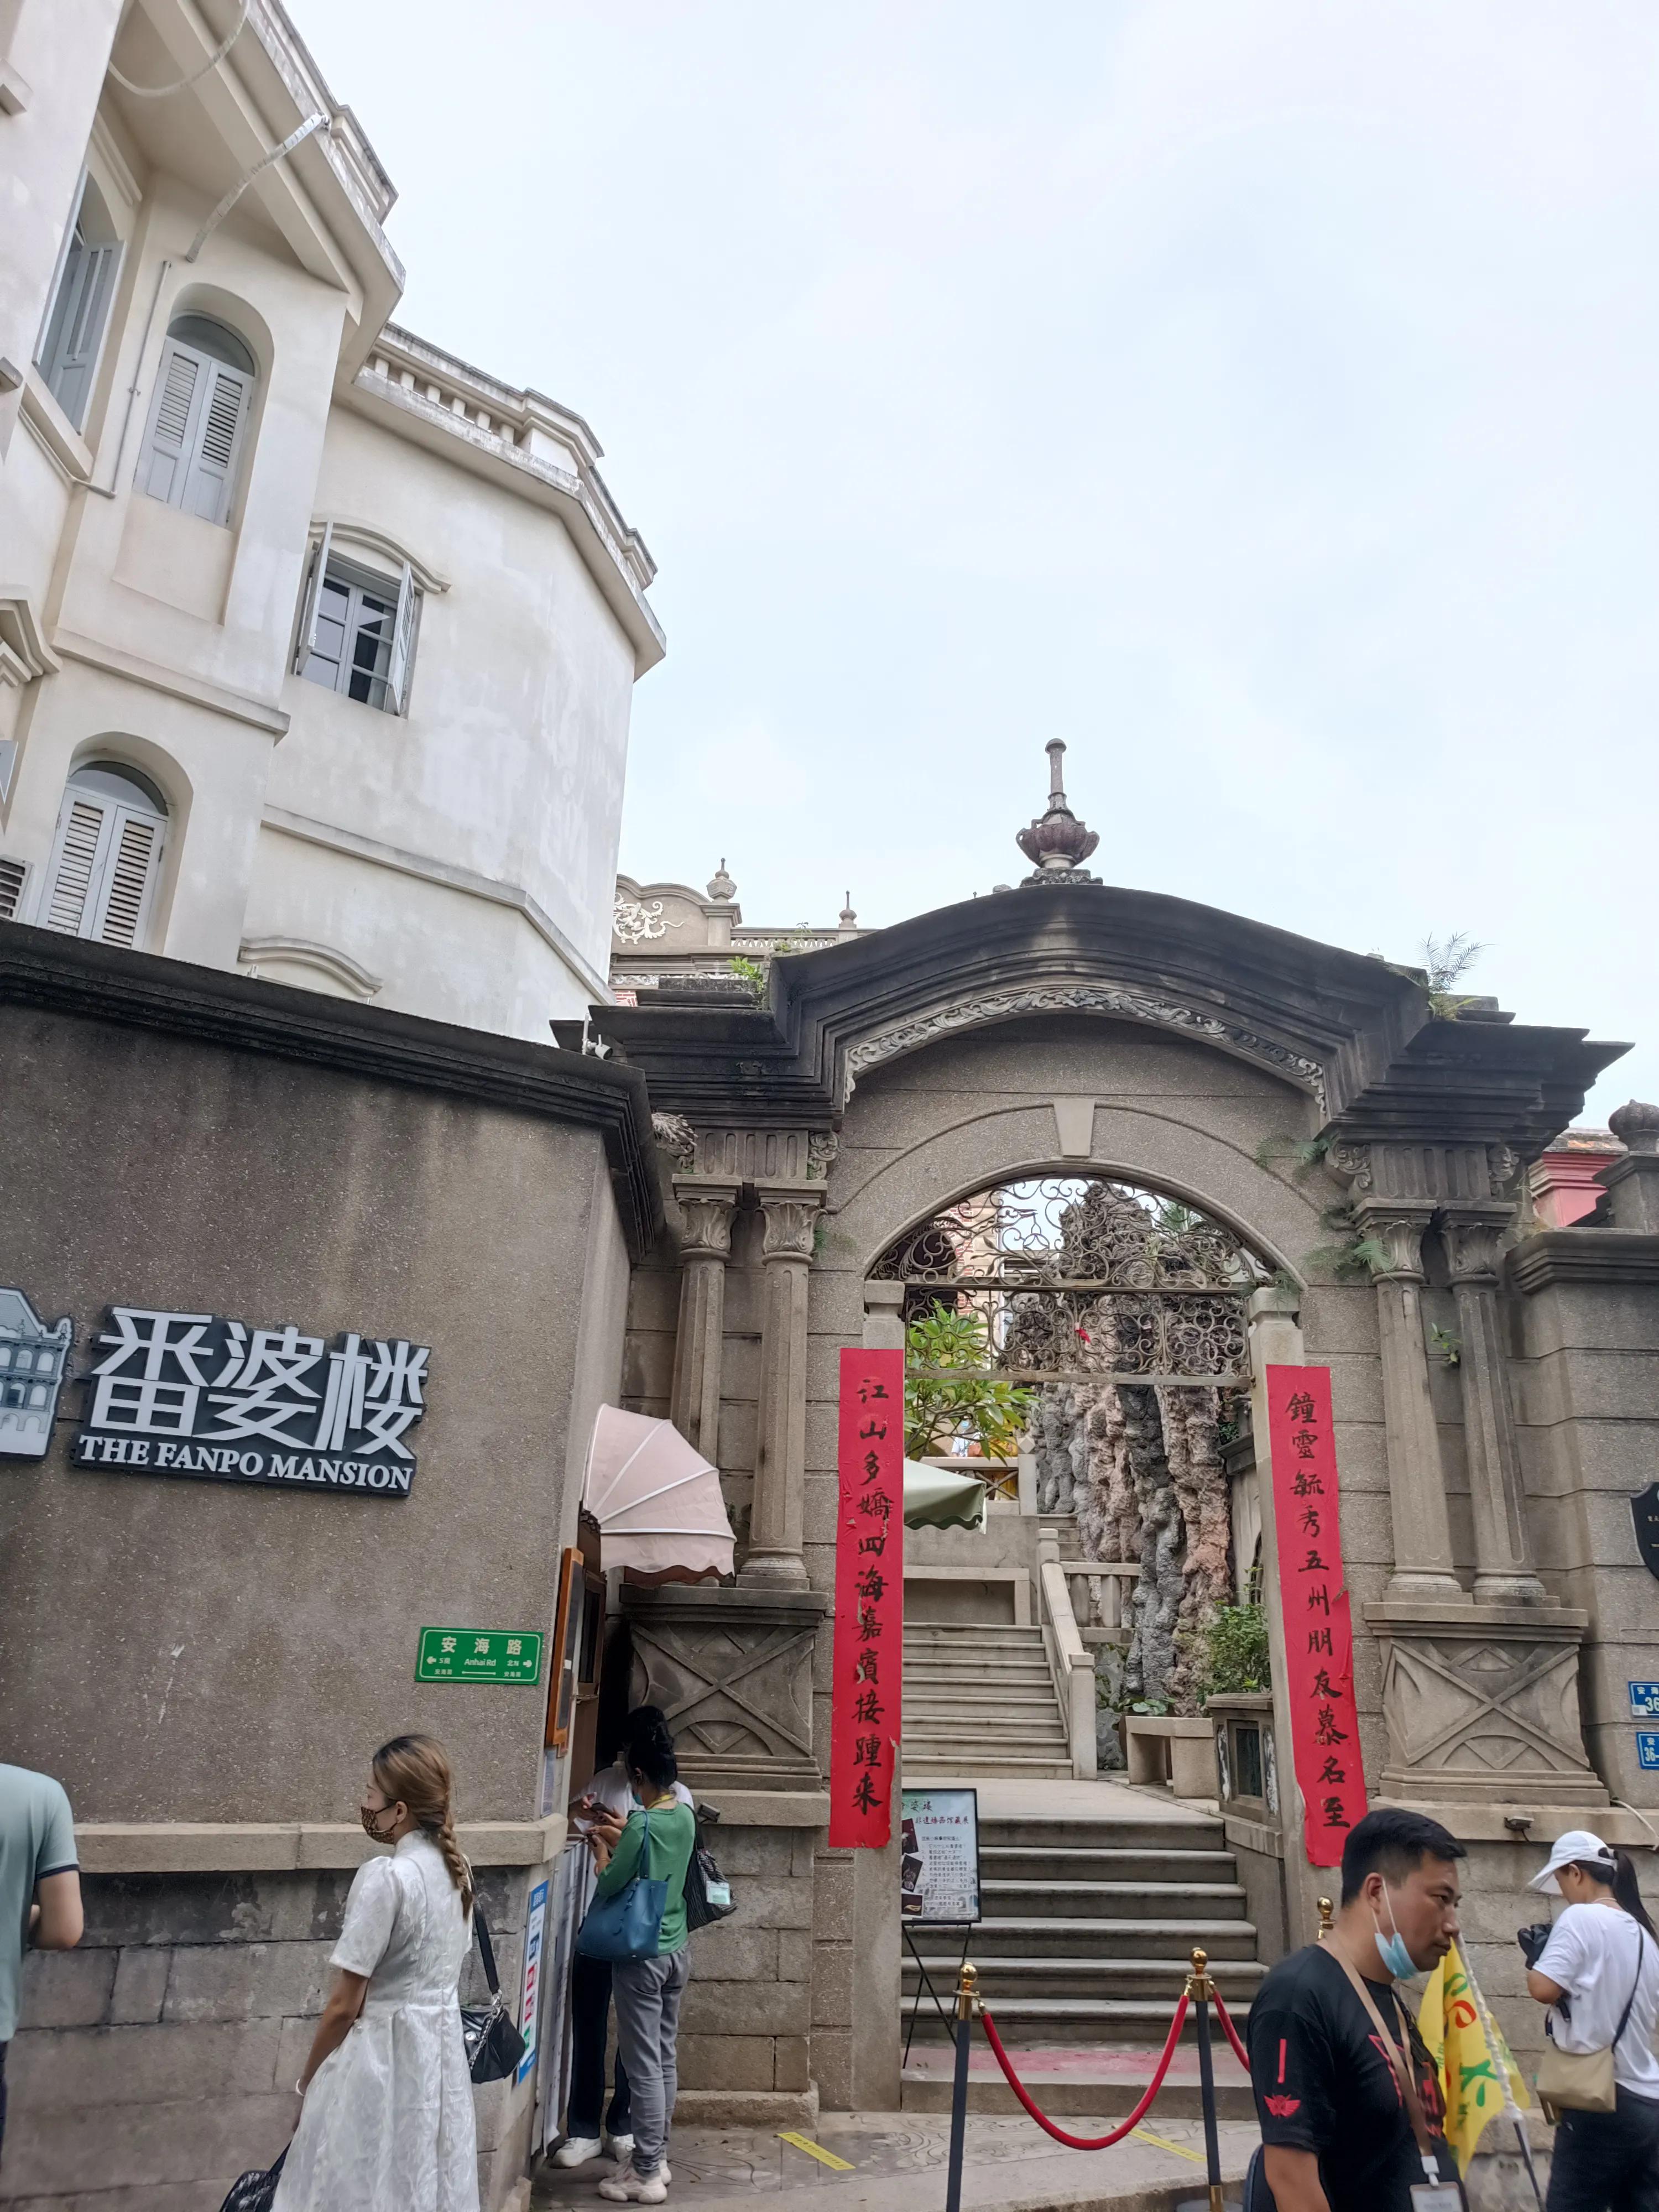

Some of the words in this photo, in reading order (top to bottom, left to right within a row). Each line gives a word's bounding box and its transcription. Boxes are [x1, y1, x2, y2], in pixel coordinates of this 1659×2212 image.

[91, 1306, 432, 1459] 番婆楼
[79, 1434, 150, 1465] THE
[154, 1442, 264, 1476] FANPO
[267, 1453, 414, 1490] MANSION
[441, 1636, 522, 1655] 安海路
